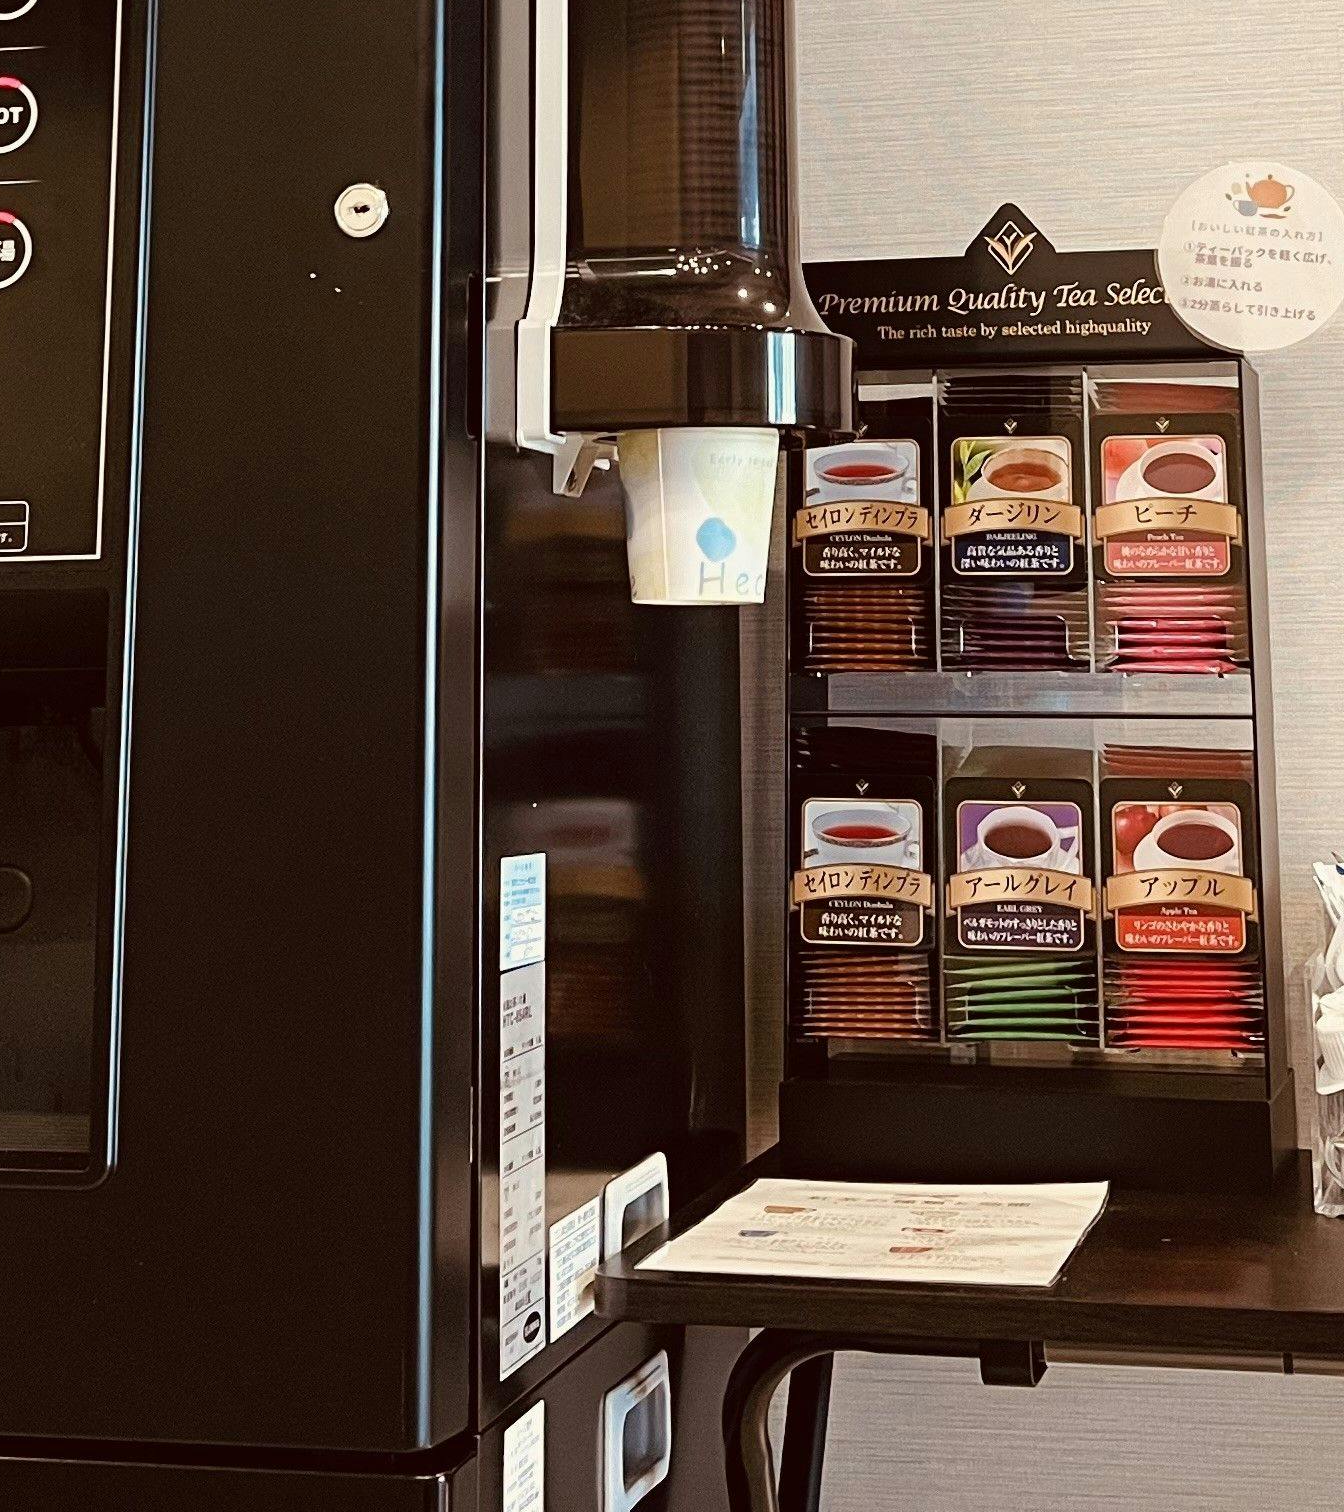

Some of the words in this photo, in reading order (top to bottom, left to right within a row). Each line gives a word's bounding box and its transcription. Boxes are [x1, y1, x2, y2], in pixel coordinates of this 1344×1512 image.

[818, 290, 940, 315] Premium
[947, 283, 1046, 316] Quality
[1053, 282, 1098, 308] Tea
[877, 325, 905, 340] The
[909, 323, 937, 339] rich
[941, 324, 977, 338] taste
[980, 322, 998, 340] by
[1001, 320, 1061, 336] selected
[1065, 318, 1152, 337] highquality
[968, 501, 1062, 527] ダージリン
[1134, 502, 1198, 524] ピーチ
[965, 873, 1078, 901] アールグレイ
[1139, 874, 1226, 898] アップル
